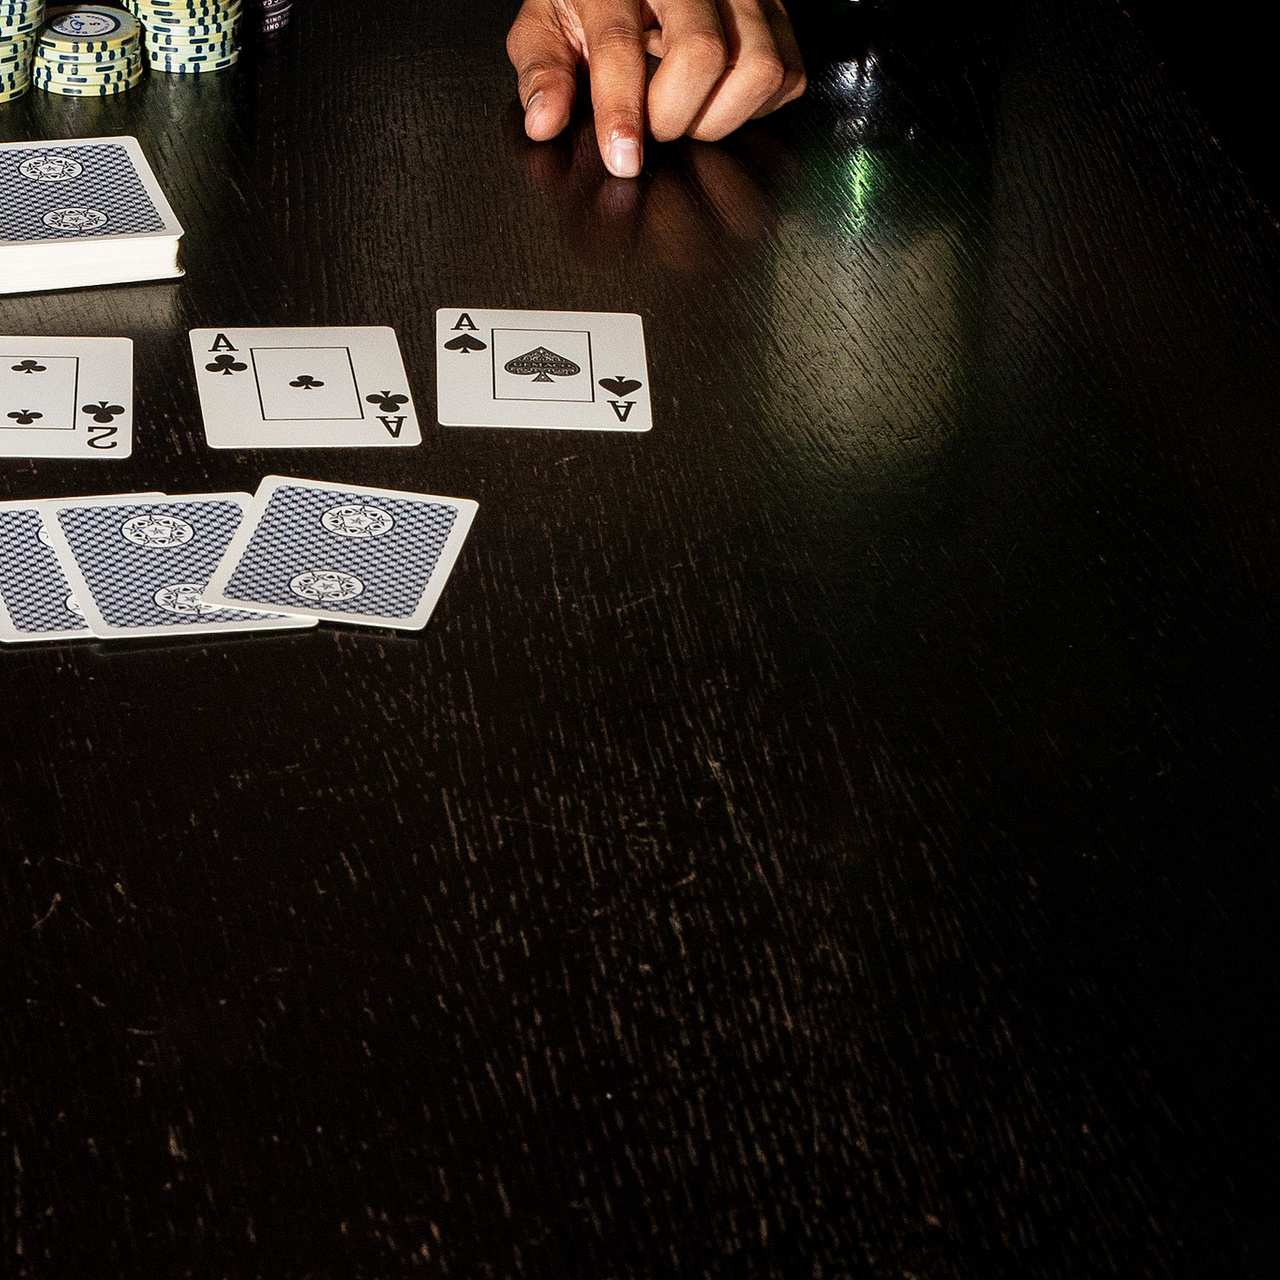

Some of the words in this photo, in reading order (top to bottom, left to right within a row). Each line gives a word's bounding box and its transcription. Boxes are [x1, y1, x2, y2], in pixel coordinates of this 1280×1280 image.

[451, 313, 479, 330] A
[208, 334, 238, 352] A
[607, 401, 636, 422] A
[376, 416, 407, 438] A
[87, 427, 117, 449] 2
